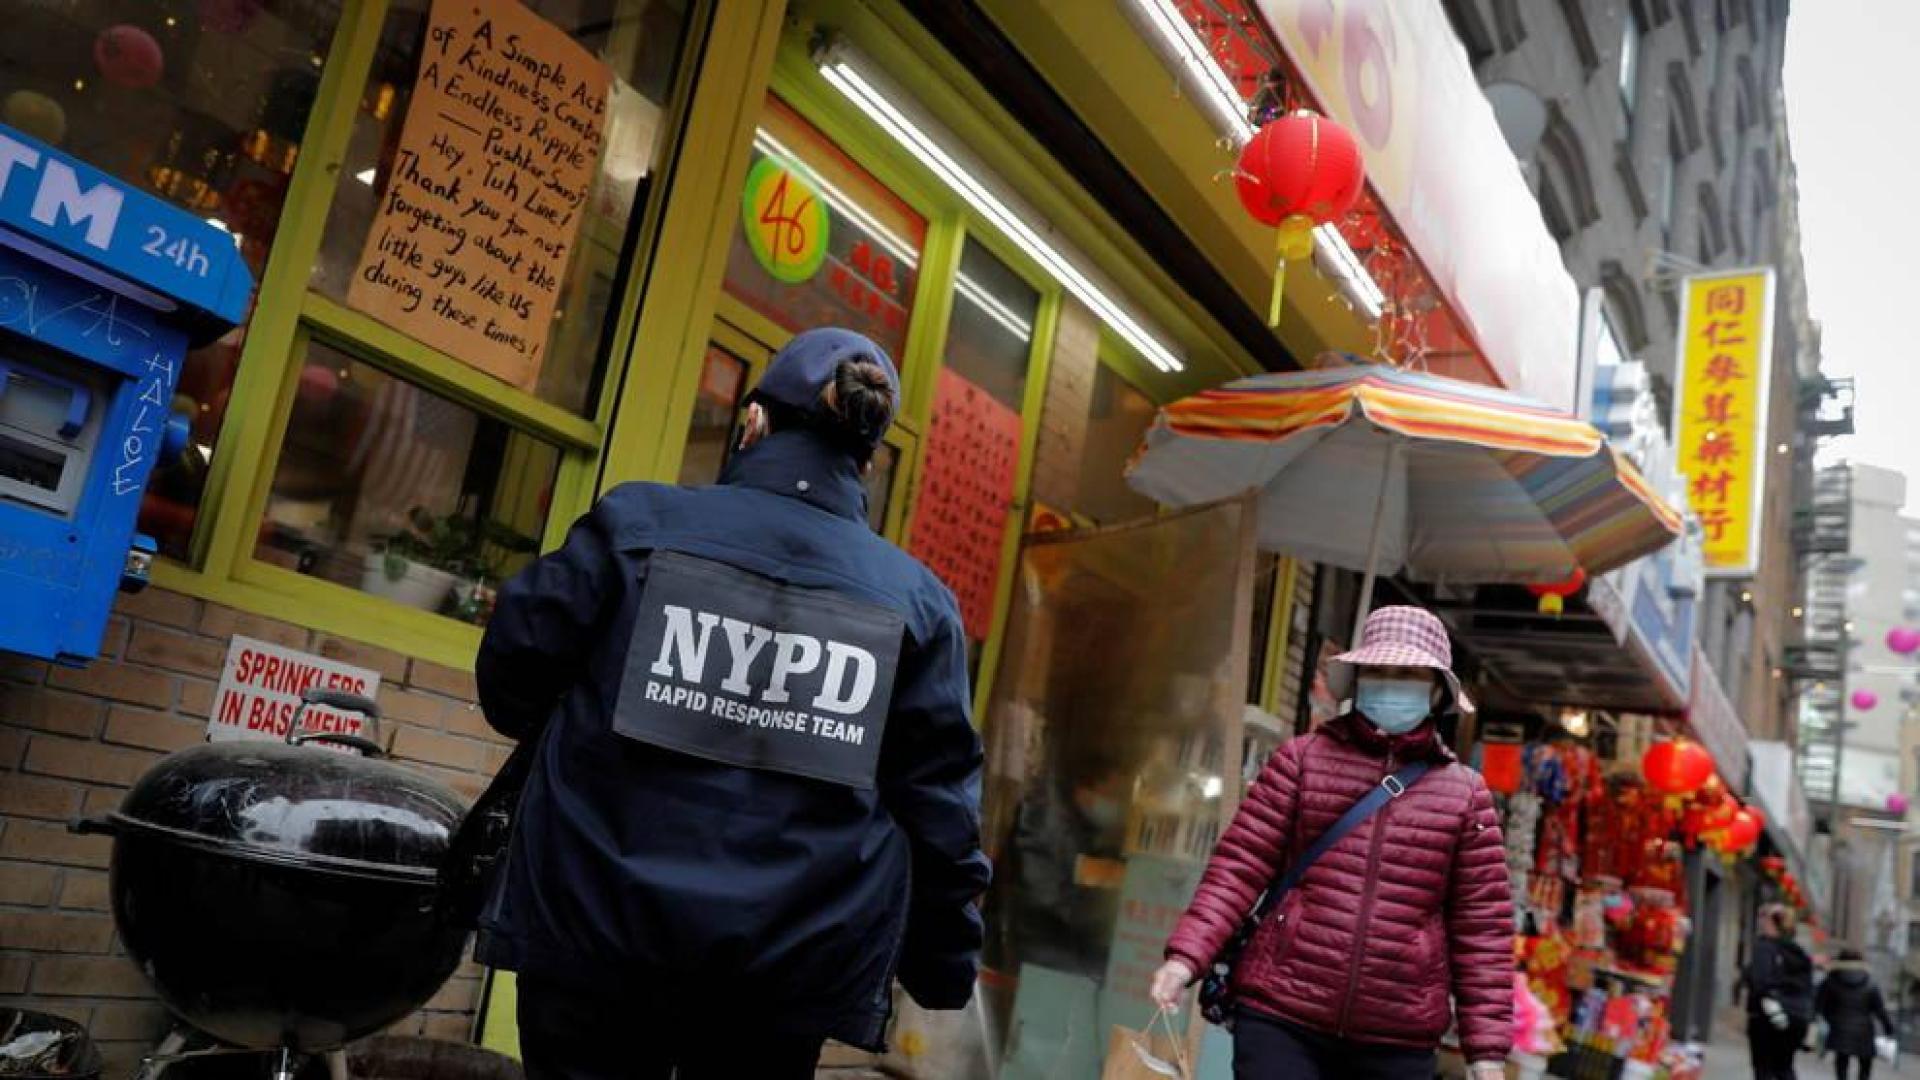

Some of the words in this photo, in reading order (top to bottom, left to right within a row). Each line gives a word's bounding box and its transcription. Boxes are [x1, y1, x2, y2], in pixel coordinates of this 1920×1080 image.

[423, 62, 438, 89] A
[444, 75, 522, 132] Endless
[432, 28, 457, 56] of
[458, 43, 550, 113] Kindness
[501, 35, 566, 91] Simple
[571, 81, 606, 114] Act
[397, 149, 461, 204] Thank
[460, 198, 500, 220] you
[533, 236, 565, 258] not
[760, 169, 816, 268] 46
[141, 224, 209, 277] 24h
[378, 226, 422, 270] little
[427, 259, 466, 289] guys
[471, 273, 504, 305] like
[473, 235, 523, 274] about
[528, 261, 555, 292] the
[363, 260, 422, 313] during
[432, 295, 477, 328] these
[651, 604, 877, 714] NYPD
[218, 690, 246, 726] IN
[247, 695, 362, 742] BASMENT
[645, 680, 707, 711] RAPID
[711, 696, 807, 732] RESPONSE
[811, 715, 864, 745] TEAM
